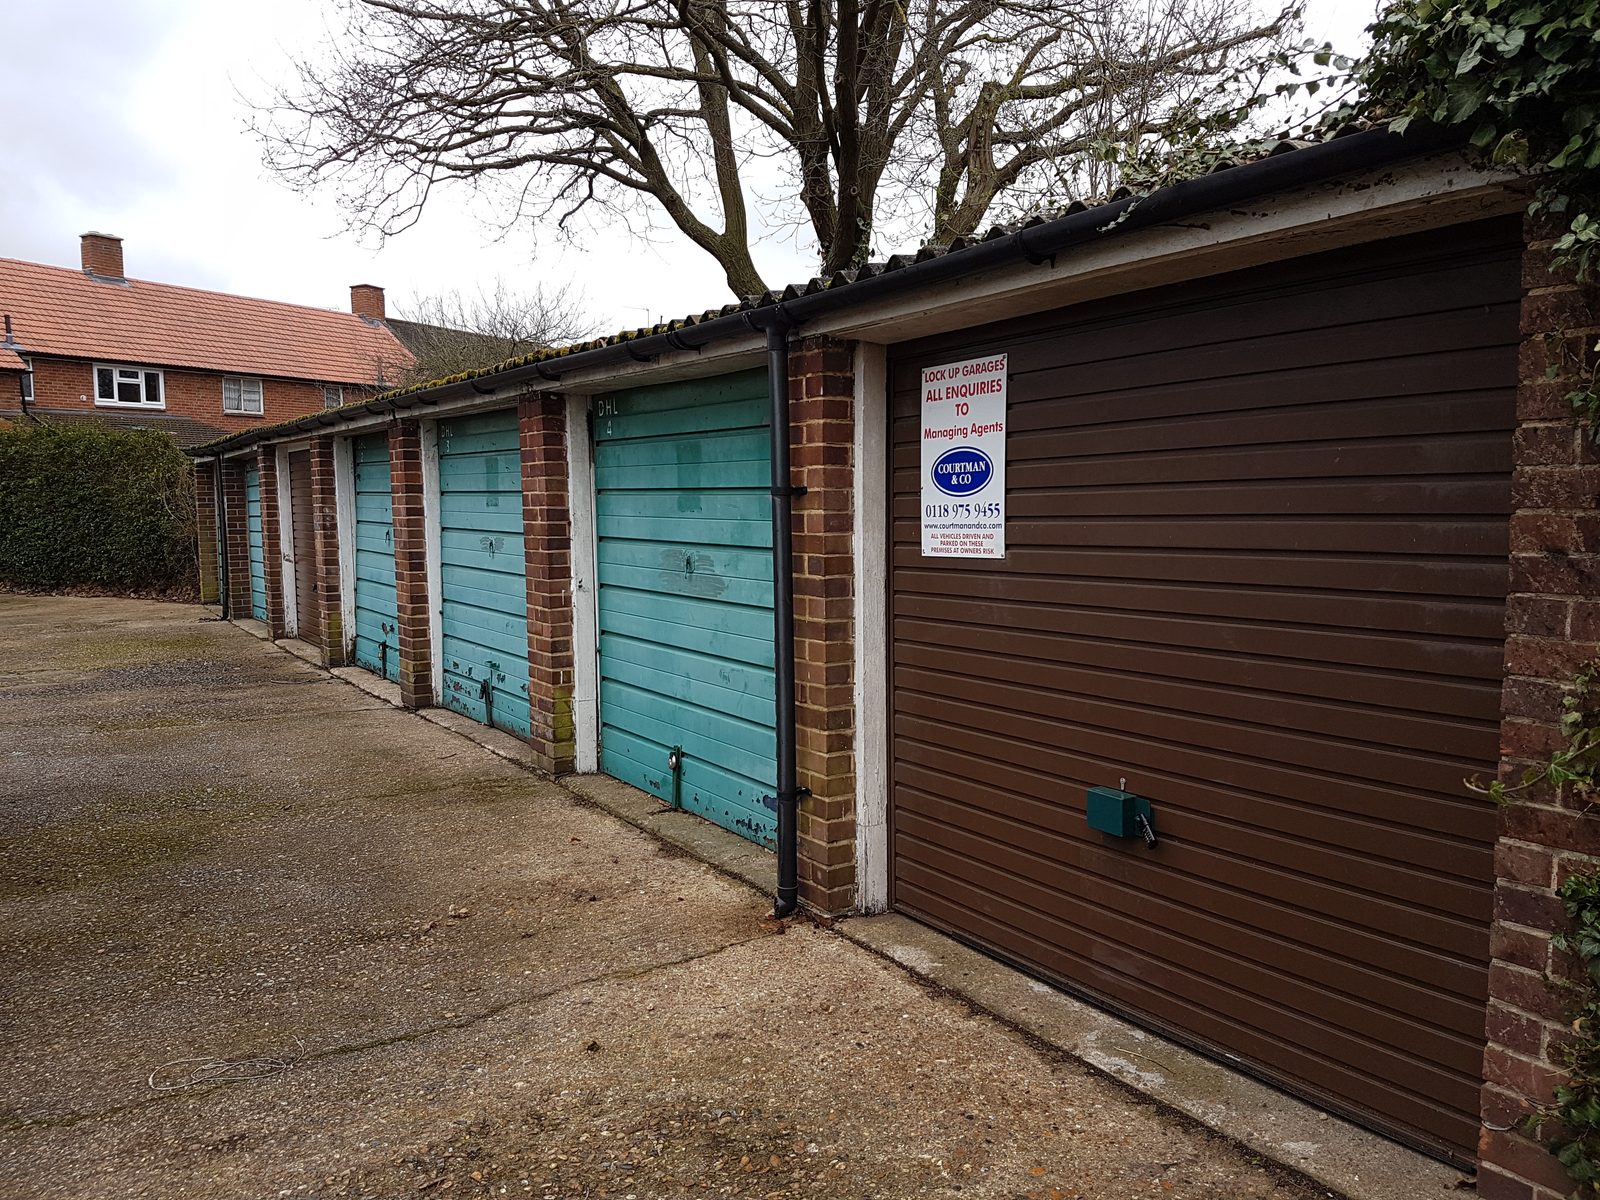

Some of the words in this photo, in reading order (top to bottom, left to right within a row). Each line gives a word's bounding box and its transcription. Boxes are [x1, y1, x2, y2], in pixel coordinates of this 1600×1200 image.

[925, 370, 946, 383] LOCK
[948, 367, 960, 379] UP
[962, 358, 1005, 376] GARAGES
[926, 388, 943, 402] ALL
[945, 378, 1003, 399] ENQUIRIES
[598, 397, 618, 416] DHL
[955, 402, 969, 416] TO
[606, 420, 612, 436] 4
[924, 425, 968, 440] Managing
[970, 421, 1004, 437] Agents
[938, 461, 986, 474] COURTMAN
[951, 475, 958, 485] &
[959, 474, 972, 484] CO
[925, 503, 949, 518] 0118
[952, 503, 971, 519] 975
[974, 501, 1001, 519] 9455
[924, 521, 1003, 530] www.courtmanandco.com
